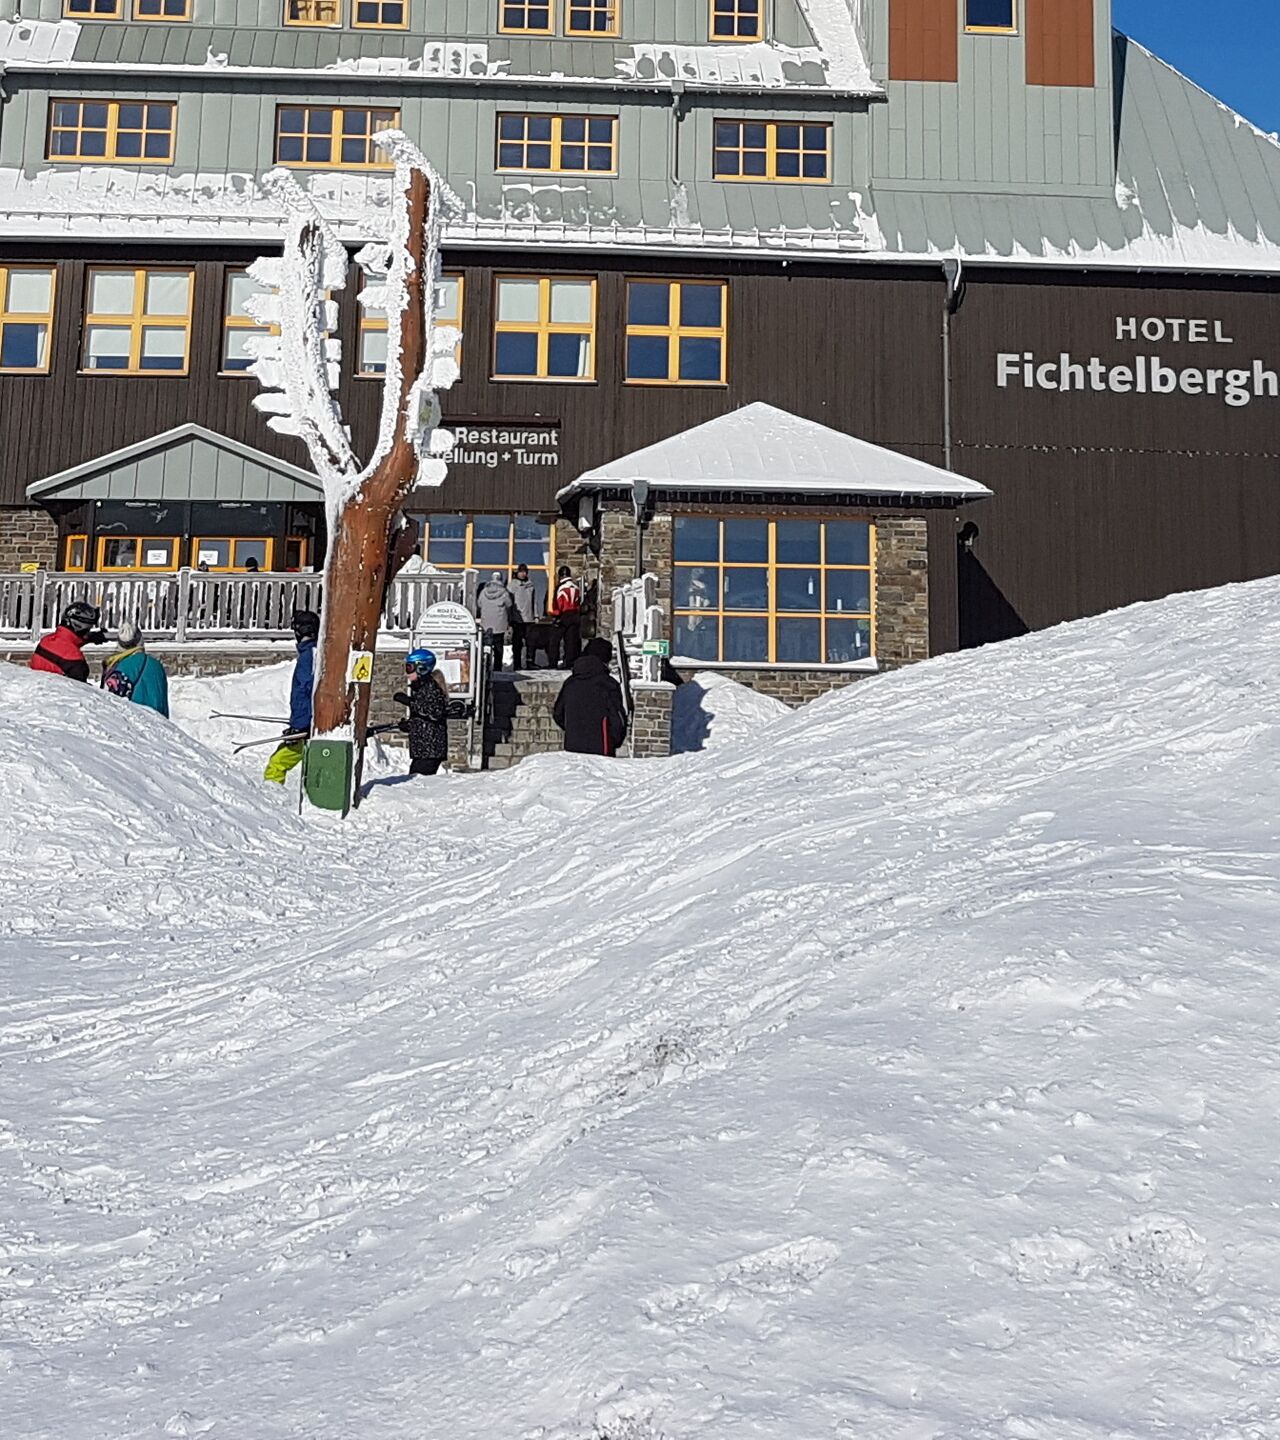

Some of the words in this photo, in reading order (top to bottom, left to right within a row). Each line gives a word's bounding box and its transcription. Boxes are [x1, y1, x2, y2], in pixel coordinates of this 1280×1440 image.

[1115, 316, 1234, 343] HOTEL
[455, 426, 559, 446] Restaurant
[513, 448, 559, 465] Turm
